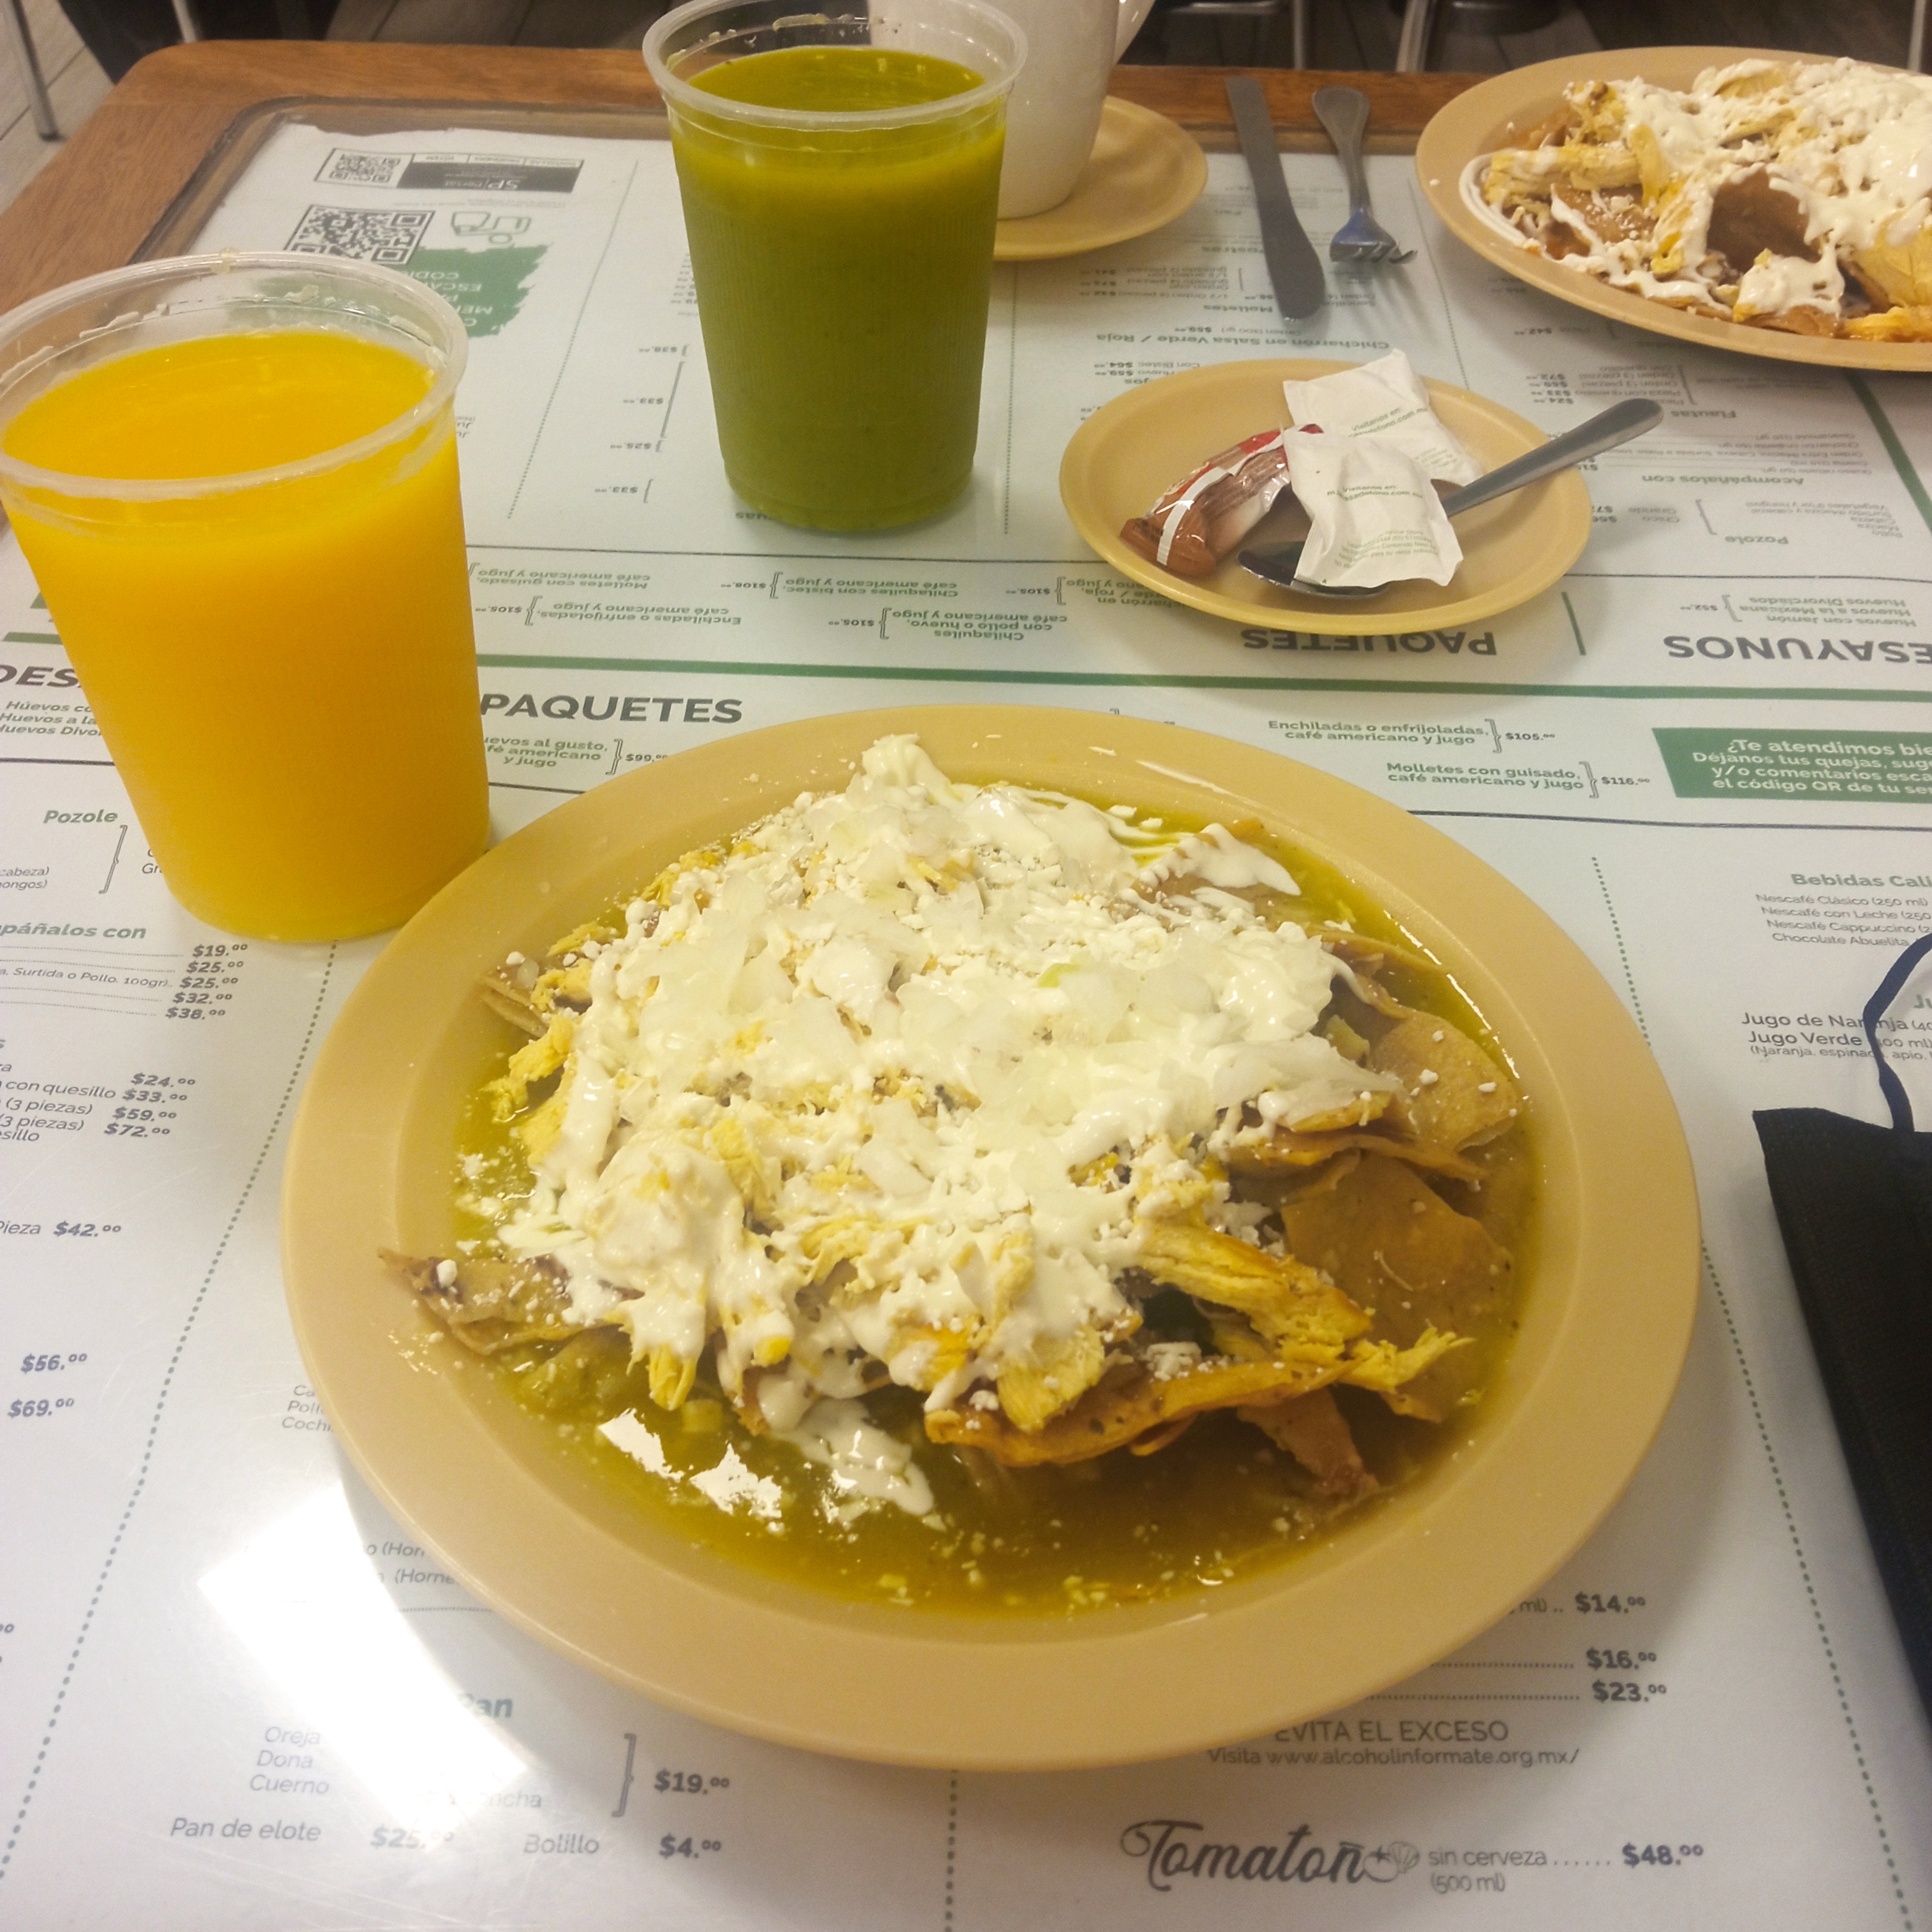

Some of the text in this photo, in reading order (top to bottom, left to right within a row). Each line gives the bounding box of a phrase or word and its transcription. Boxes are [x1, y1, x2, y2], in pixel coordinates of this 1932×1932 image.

[1097, 334, 1134, 342] Roja
[1212, 337, 1260, 346] Salsa
[1671, 410, 1736, 419] Flautas
[1642, 475, 1674, 483] con
[1725, 536, 1788, 544] Pozole
[478, 568, 515, 578] jugo
[529, 572, 612, 580] americano
[580, 580, 647, 590] Molletes
[785, 577, 957, 591] café americano jugo
[1066, 579, 1102, 588] jugo
[870, 587, 959, 598] Chilaquiles
[552, 602, 729, 616] café americano jugo
[1749, 597, 1906, 607] Huevos Divorciados
[892, 609, 1068, 624] café americano jugo
[1739, 606, 1816, 614] Mexicana
[1849, 607, 1911, 617] Huevos
[537, 611, 741, 625] Enchiladas enfrijoladas,
[828, 619, 875, 627] $105.00
[907, 619, 1052, 631] con pollo huevo,
[1766, 616, 1917, 627] Huevos con Jamón
[933, 630, 1024, 642] Chilaquiles
[1240, 629, 1497, 656] PAQUETES
[0, 664, 82, 688] DES
[479, 693, 742, 723] PAQUETES
[0, 713, 63, 723] Huevos
[1269, 720, 1489, 736] Enchiladas enfrijoladas,
[1285, 729, 1475, 745] café americano jugo
[1505, 732, 1556, 741] $105.00
[534, 738, 607, 752] al gusto,
[1727, 739, 1895, 755] ¿Te atendimos
[508, 748, 601, 761] americano
[515, 755, 558, 768] jugo
[1692, 752, 1775, 765] Déjanos
[1778, 755, 1811, 765] tus
[1387, 762, 1463, 774] Molletes
[1468, 766, 1501, 775] con
[1756, 767, 1882, 781] comentarios
[1388, 772, 1584, 790] café americano jugo
[1712, 778, 1900, 793] el código QR de tu
[43, 809, 118, 824] Pozole
[1791, 873, 1885, 887] Bebidas
[1756, 894, 1814, 904] Nescafé
[1817, 895, 1869, 906] Clásico
[1873, 897, 1902, 907] (250
[1761, 907, 1821, 917] Nescafé
[1824, 910, 1850, 918] con
[1855, 910, 1898, 919] Leche
[102, 927, 147, 939] con
[1767, 920, 1916, 933] Nescafé Cappuccino
[1772, 932, 1910, 946] Chocolate Abuelita
[192, 944, 248, 958] $19.00
[14, 967, 64, 978] Surtida
[186, 960, 243, 973] $25.00
[180, 977, 238, 989] $25.00
[173, 992, 232, 1004] $32.00
[165, 1007, 226, 1020] $38.00
[1741, 1012, 1824, 1028] Jugo de
[1749, 1030, 1863, 1046] Jugo Verde
[131, 1072, 196, 1087] $24.00
[6, 1081, 188, 1103] con quesillo $33.00
[6, 1097, 177, 1122] (3 piezas) $59.00
[16, 1116, 170, 1138] piezas) $72.00
[53, 1220, 122, 1237] $42.00
[20, 1353, 88, 1374] $56.00
[7, 1398, 75, 1419] $69.00
[1574, 1591, 1647, 1616] $14.00
[1585, 1647, 1658, 1671] $16.00
[1591, 1679, 1668, 1704] $23.00
[264, 1726, 321, 1747] Oreja
[1274, 1719, 1510, 1743] EVITA EL EXCESO
[256, 1749, 313, 1769] Dona
[1207, 1747, 1263, 1766] Visita
[249, 1773, 330, 1796] Cuerno
[653, 1768, 730, 1795] $19.00
[170, 1817, 214, 1838] Pan
[222, 1819, 253, 1839] de
[258, 1819, 322, 1842] elote
[523, 1832, 721, 1860] Bolillo $4.00
[1429, 1843, 1704, 1868] sin cerveza $48.00
[1429, 1871, 1506, 1894] (500 ml)
